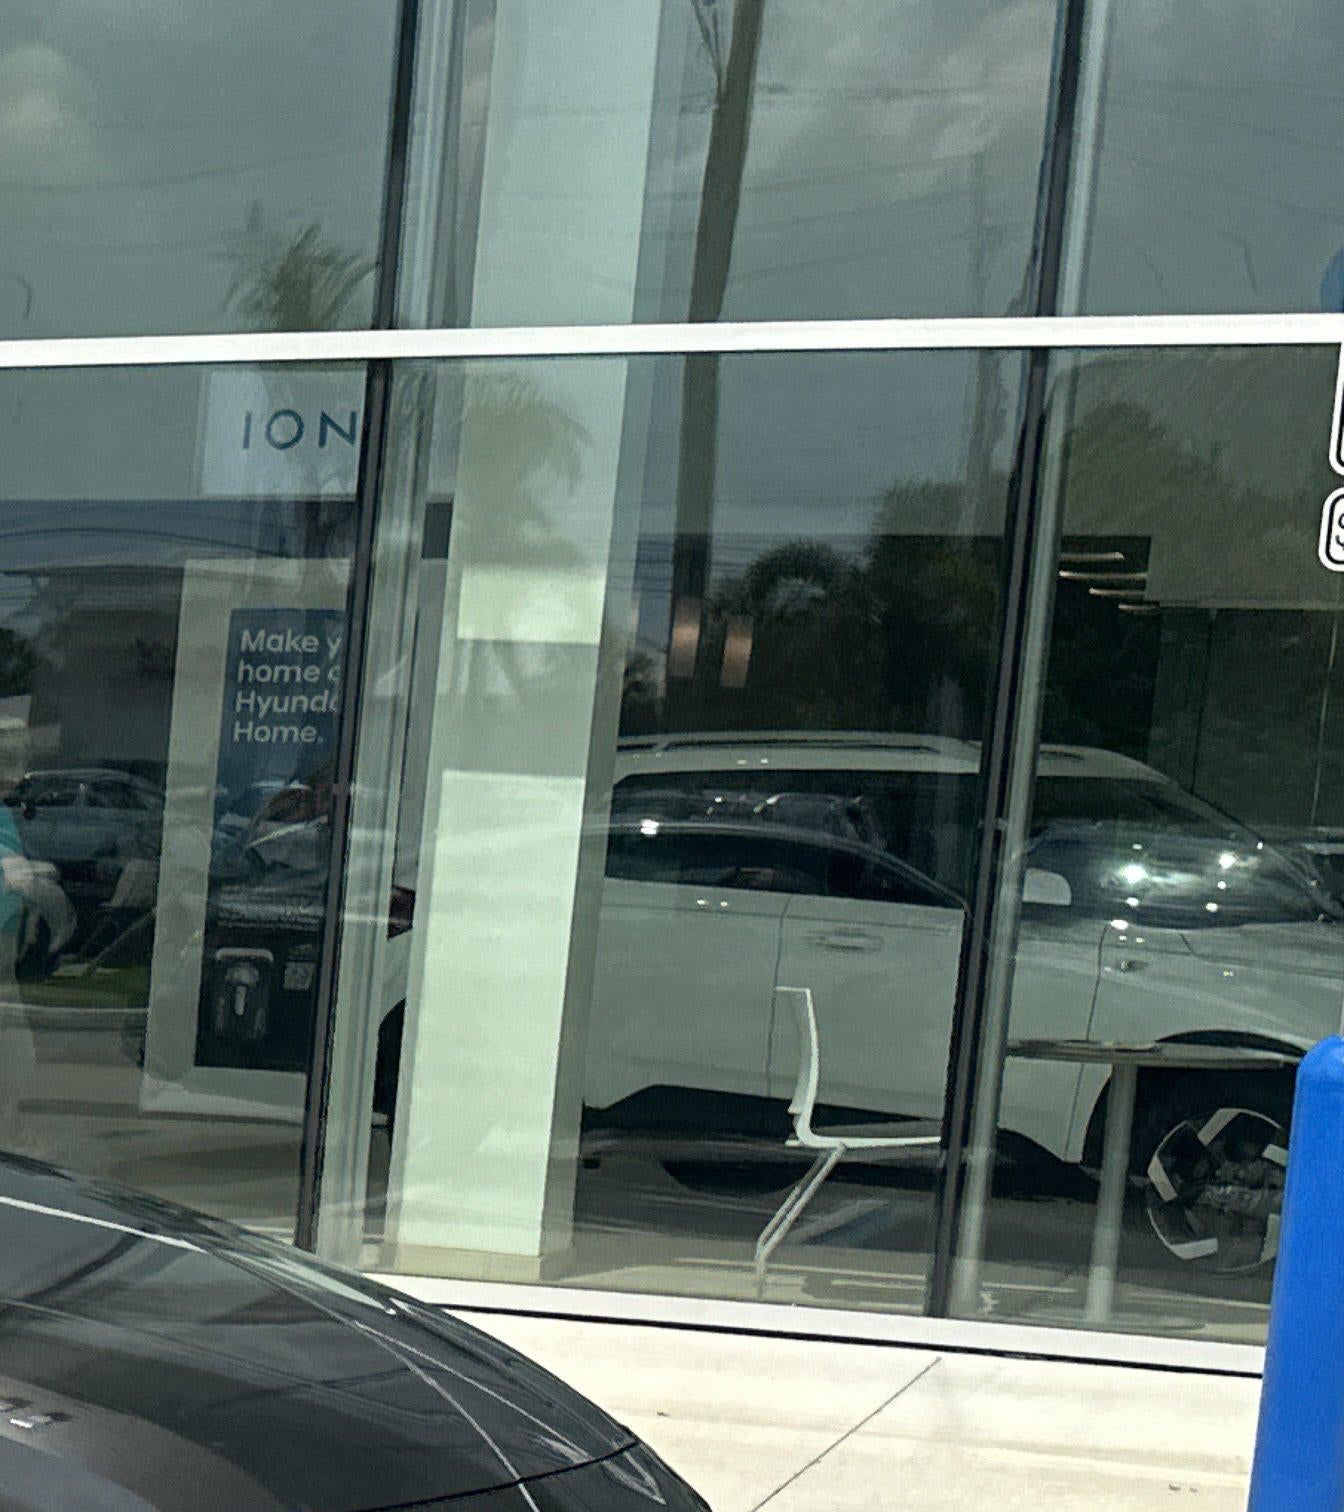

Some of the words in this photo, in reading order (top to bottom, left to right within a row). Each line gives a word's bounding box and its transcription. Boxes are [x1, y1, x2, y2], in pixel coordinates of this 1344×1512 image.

[243, 409, 358, 449] ION
[240, 629, 320, 653] Make
[237, 659, 321, 684] home
[233, 720, 325, 744] Home.
